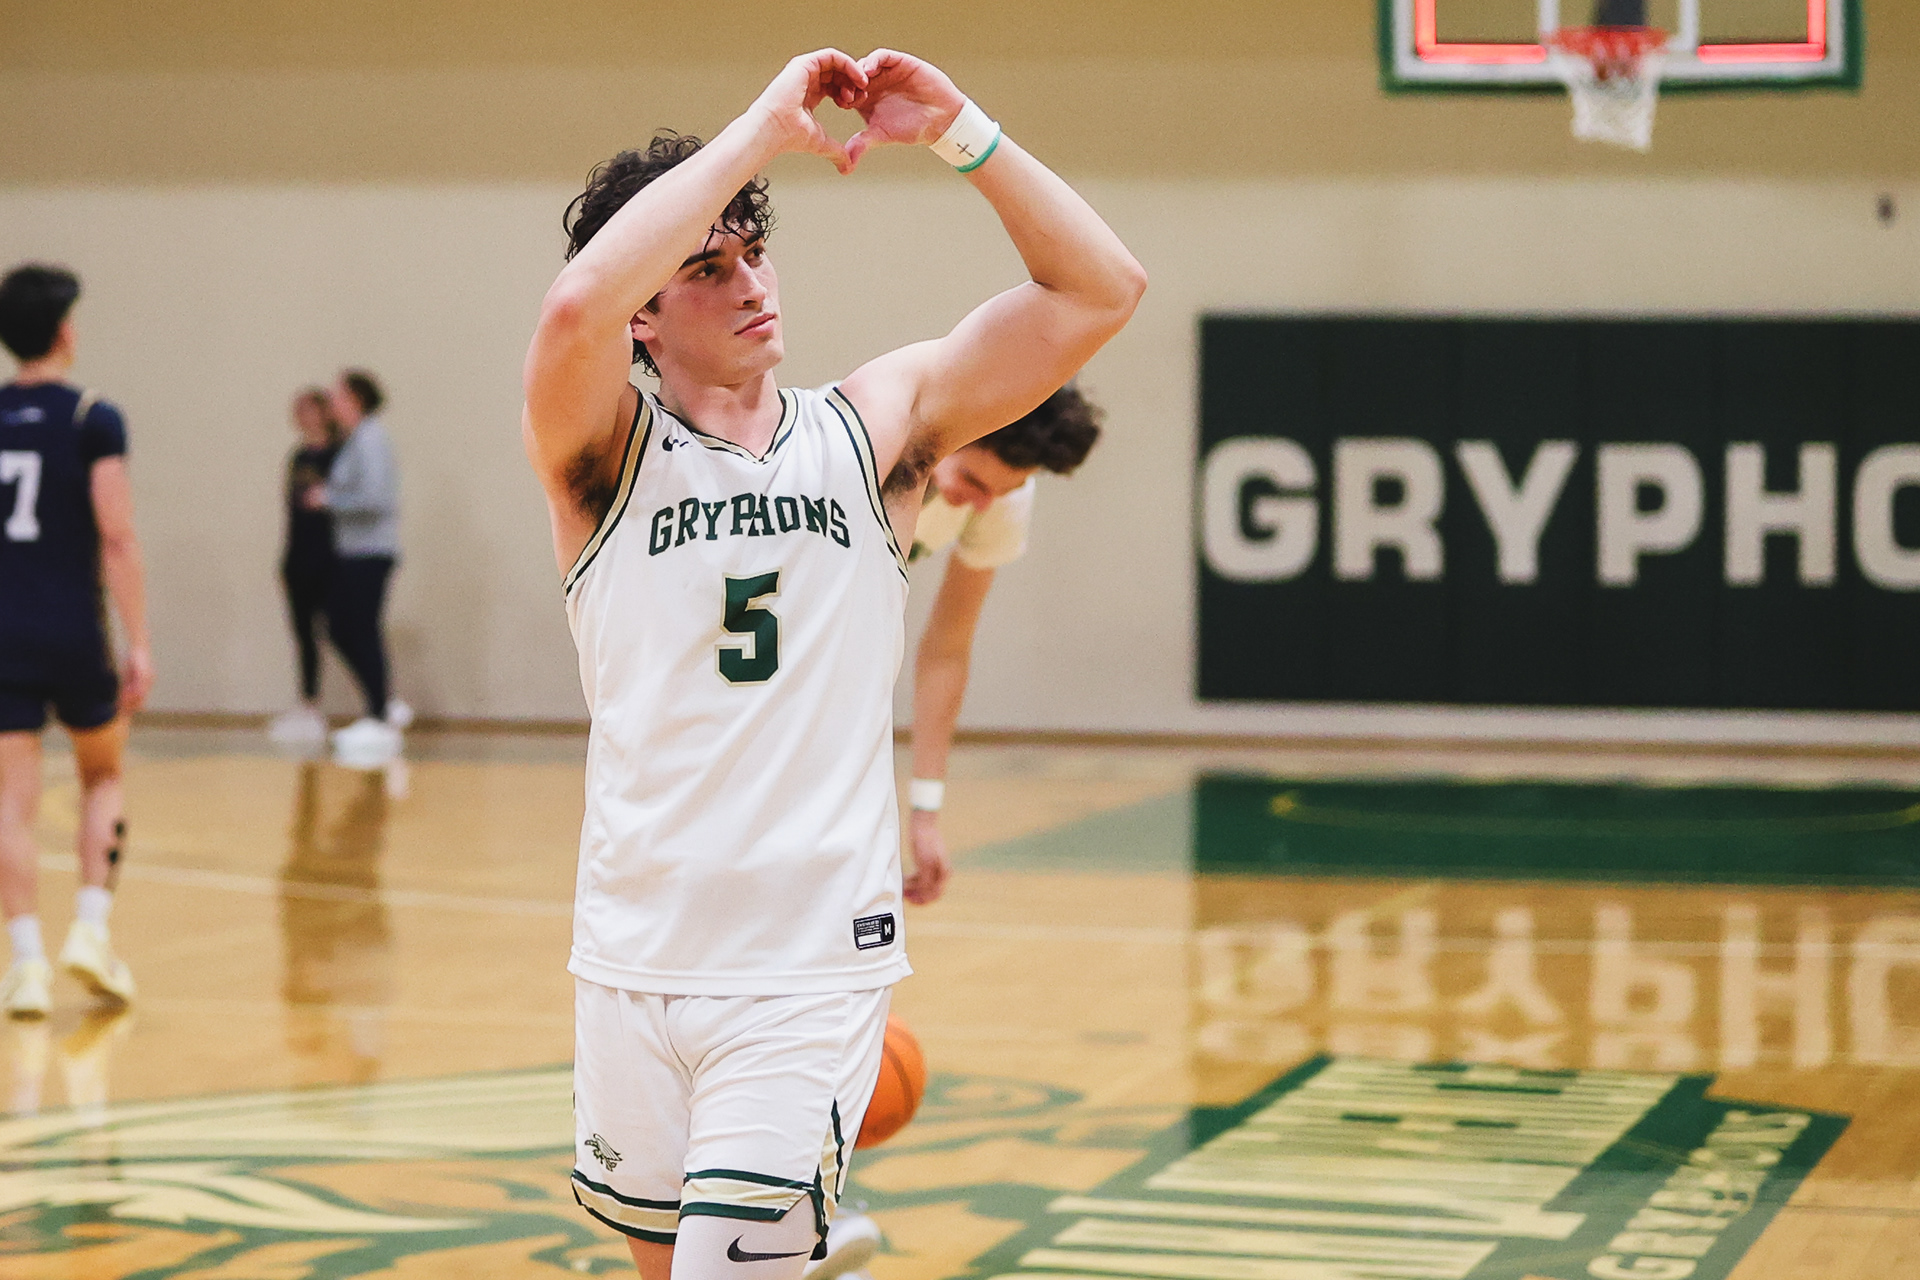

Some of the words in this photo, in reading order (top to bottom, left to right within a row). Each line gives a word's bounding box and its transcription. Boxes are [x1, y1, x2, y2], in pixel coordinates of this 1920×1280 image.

[648, 492, 851, 557] GRYPHONS
[1203, 436, 1920, 590] GRYPHO
[715, 567, 782, 687] 5
